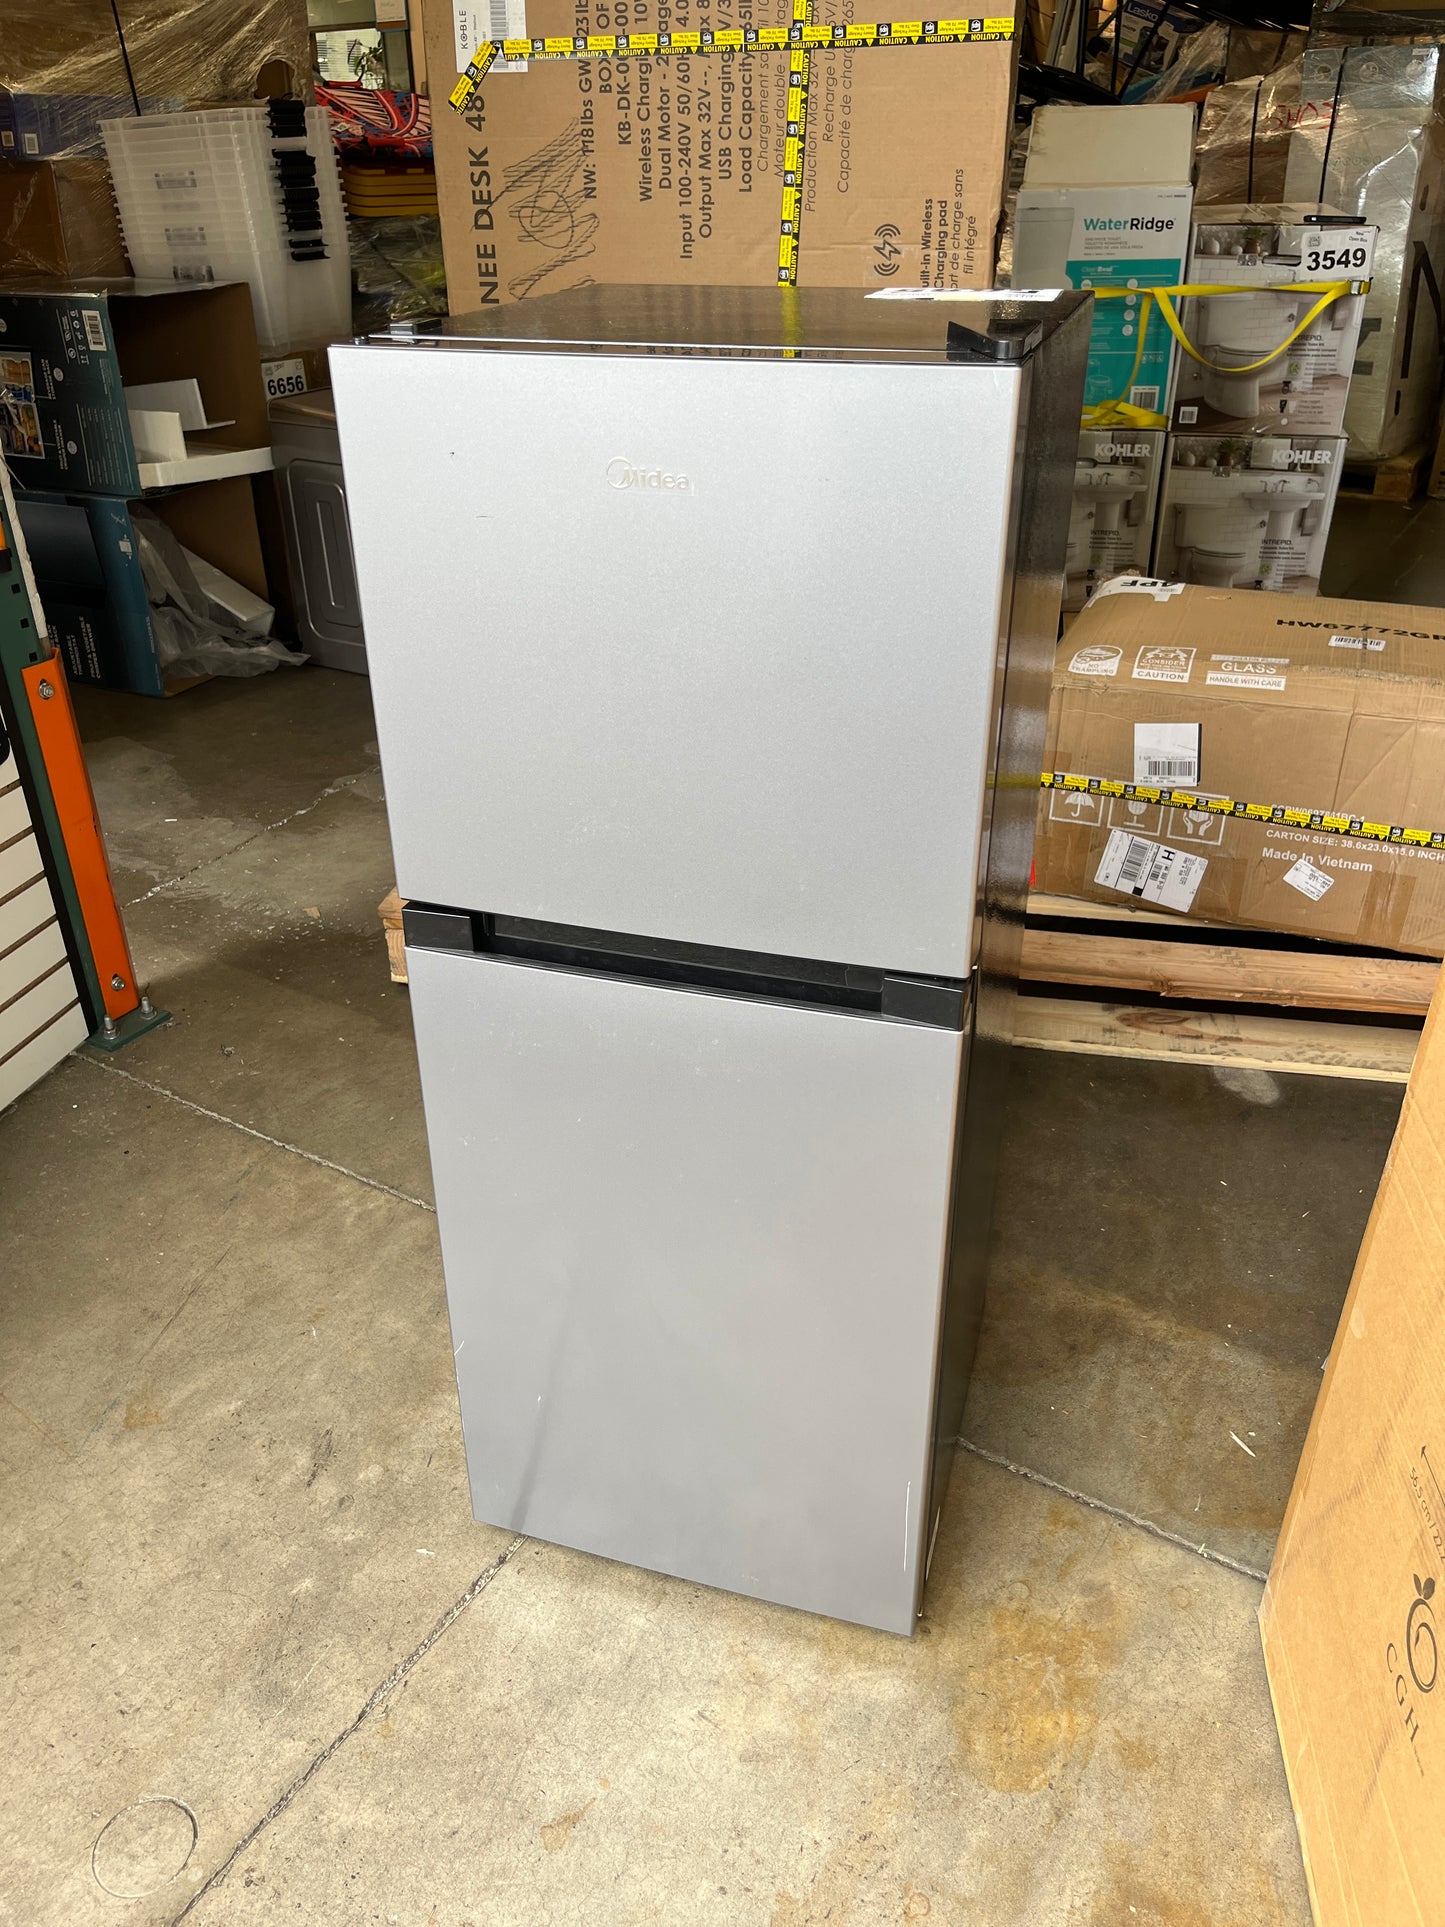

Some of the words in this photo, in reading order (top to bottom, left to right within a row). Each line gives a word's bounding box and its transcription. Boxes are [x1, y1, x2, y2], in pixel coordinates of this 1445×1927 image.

[459, 10, 468, 50] KOBLE
[596, 4, 610, 29] OF
[812, 4, 820, 24] ax
[661, 46, 687, 54] CAUTION
[835, 39, 863, 47] CAUTION
[926, 35, 953, 43] CAUTION
[476, 58, 492, 83] CAUTION
[636, 33, 652, 121] Chargi
[676, 55, 692, 116] 50/60H
[802, 53, 810, 85] CAUTION
[841, 47, 856, 89] charg
[718, 52, 735, 140] Charging
[739, 50, 756, 140] Capacity
[774, 64, 785, 119] double
[808, 94, 818, 126] Max
[823, 65, 838, 142] Recharge
[842, 94, 852, 116] de
[657, 85, 671, 141] Motor
[757, 73, 771, 172] Chargement
[638, 128, 652, 202] Wireless
[658, 148, 672, 189] Dual
[678, 122, 692, 207] 100-240V
[698, 129, 711, 170] Max
[719, 147, 732, 179] USB
[739, 147, 752, 192] Load
[774, 124, 785, 177] Moteur
[837, 120, 852, 193] Capacité
[468, 146, 494, 230] DESK
[583, 162, 597, 199] NW:
[805, 133, 817, 212] Production
[955, 168, 964, 198] sans
[699, 176, 714, 238] Output
[921, 198, 933, 250] Wireless
[937, 200, 948, 227] pad
[951, 201, 964, 249] charge
[1084, 217, 1174, 232] WaterRidge
[679, 214, 695, 258] Input
[964, 215, 978, 262] intégré
[934, 231, 948, 288] Charging
[949, 252, 960, 270] de
[963, 263, 973, 274] fil
[1306, 248, 1366, 271] 3549
[268, 375, 304, 395] 6656
[1095, 443, 1150, 457] KOHLER
[1272, 450, 1332, 464] KOHLER
[607, 456, 689, 490] Midea
[1138, 671, 1184, 680] CAUTION
[1210, 676, 1238, 684] HANDLE
[1222, 662, 1276, 674] GLASS
[1090, 788, 1112, 796] CAUTION
[1125, 794, 1147, 802] CAUTION
[1161, 800, 1184, 808] CAUTION
[1235, 812, 1259, 820] CAUTION
[1273, 818, 1297, 826] CAUTION
[1311, 824, 1335, 832] CAUTION
[1350, 830, 1375, 838] CAUTION
[1391, 836, 1417, 845] CAUTION
[1262, 847, 1297, 861] Made
[1318, 855, 1373, 872] Vietnam
[1266, 830, 1310, 842] CARTON
[1312, 836, 1338, 845] SIZE:
[1341, 840, 1414, 857] 38.6x23.0x15.0
